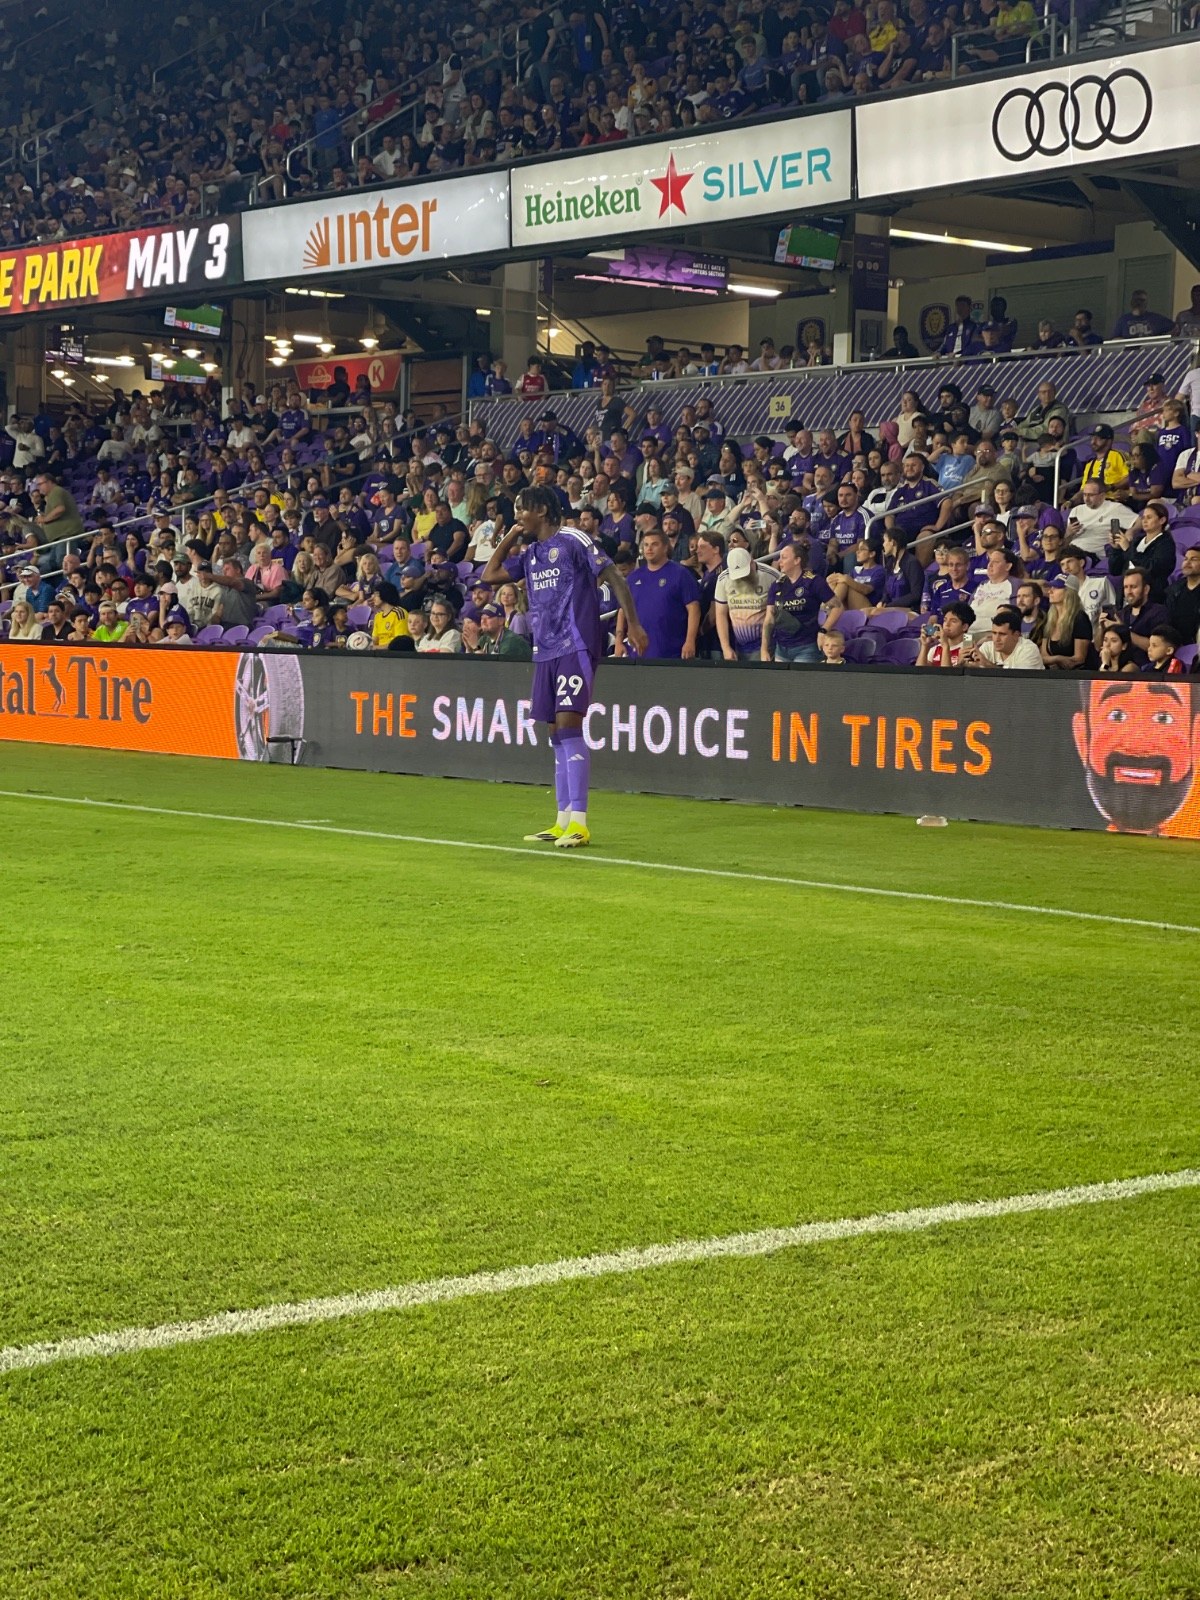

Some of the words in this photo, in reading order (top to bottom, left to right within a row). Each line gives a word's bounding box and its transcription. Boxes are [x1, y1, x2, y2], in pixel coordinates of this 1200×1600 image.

[525, 185, 641, 226] Heineken
[703, 147, 832, 202] SILVER
[23, 245, 103, 305] PARK
[126, 228, 199, 290] MAY
[205, 223, 229, 280] 3
[337, 197, 437, 264] inter
[372, 365, 383, 382] K
[775, 401, 785, 411] 36
[1159, 434, 1180, 446] CSC
[67, 656, 152, 724] Tire
[557, 675, 583, 695] 29
[350, 691, 417, 738] THE
[432, 696, 553, 747] SMAR
[582, 702, 749, 759] CHOICE
[772, 711, 818, 764] IN
[842, 715, 991, 776] TIRES
